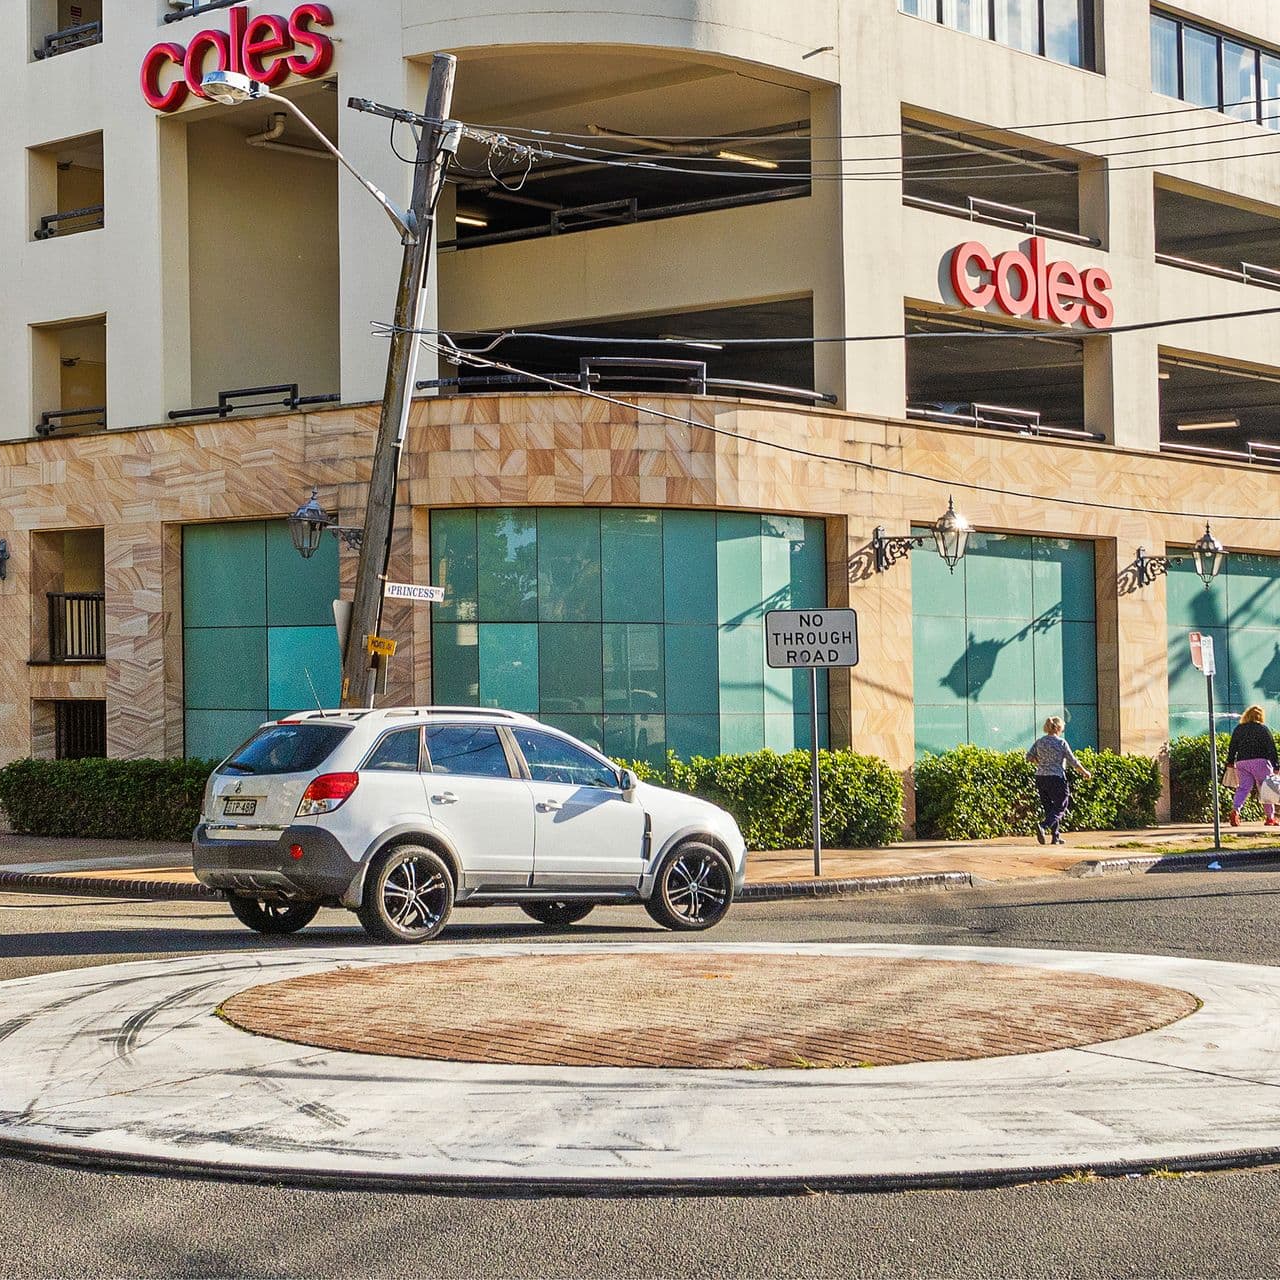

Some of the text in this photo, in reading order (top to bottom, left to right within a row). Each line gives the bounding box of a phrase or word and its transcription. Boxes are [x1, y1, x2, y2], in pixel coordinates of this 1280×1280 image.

[140, 3, 334, 112] coles
[950, 237, 1114, 329] coles
[391, 585, 434, 599] PRINCESS
[799, 614, 823, 627] NO
[772, 631, 852, 646] THROUGH
[787, 650, 839, 663] ROAD
